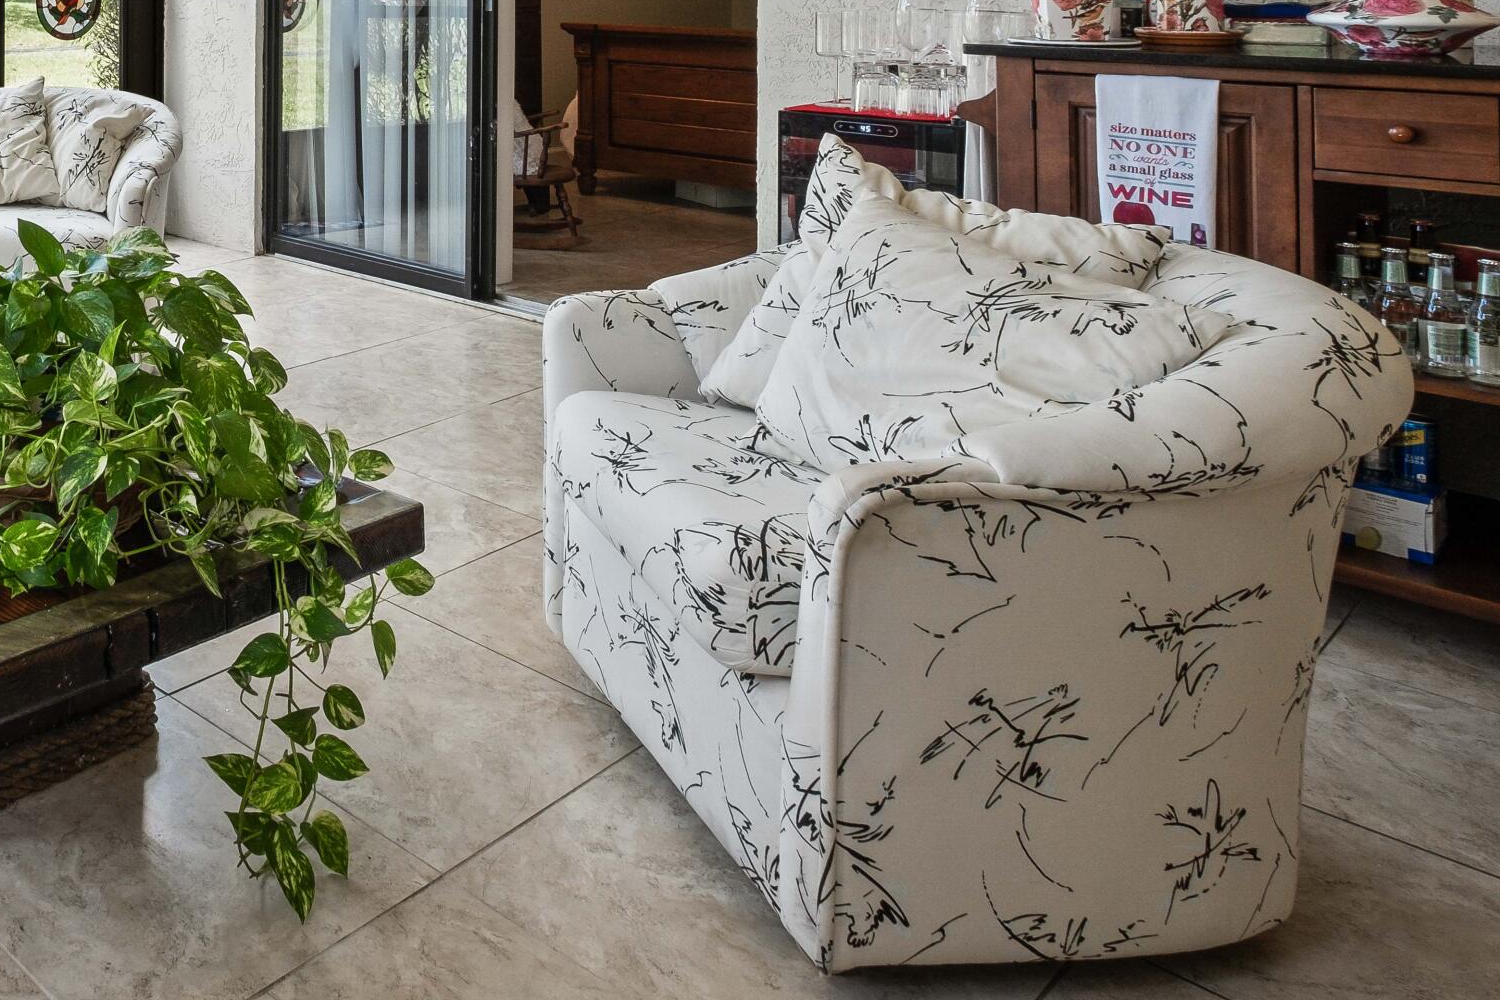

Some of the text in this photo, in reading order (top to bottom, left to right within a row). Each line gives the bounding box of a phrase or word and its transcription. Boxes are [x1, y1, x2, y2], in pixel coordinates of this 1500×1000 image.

[860, 125, 871, 133] 45
[1110, 123, 1196, 141] size matters
[1108, 139, 1195, 159] NO ONE
[1133, 155, 1169, 165] wants
[1109, 163, 1194, 180] a small glass
[1144, 178, 1155, 187] of
[1108, 183, 1194, 209] WINE
